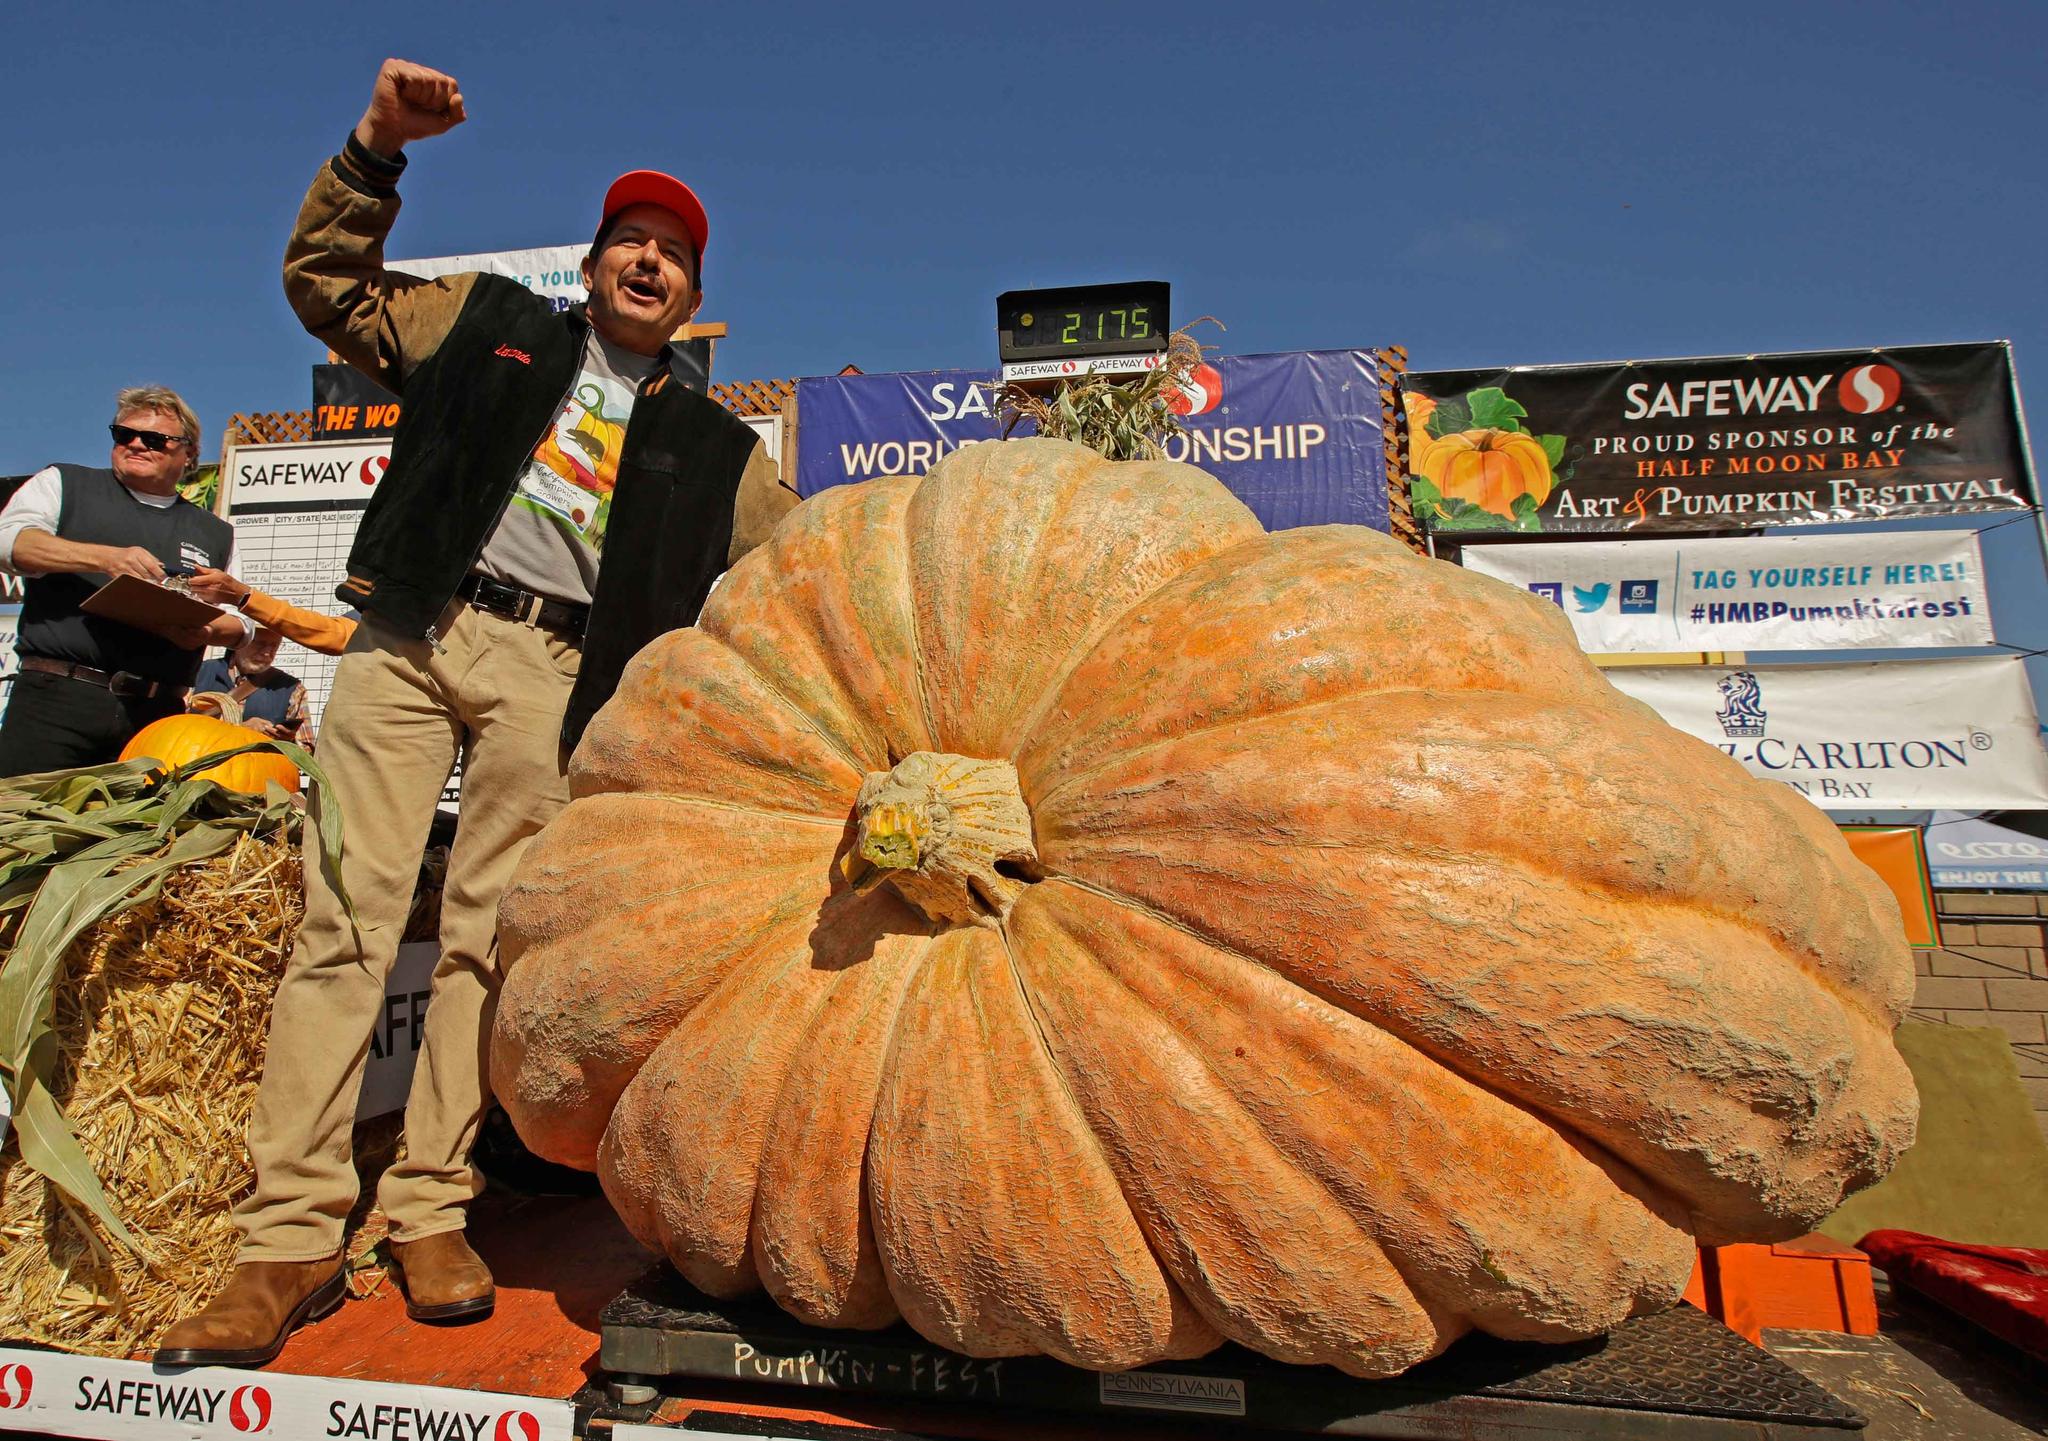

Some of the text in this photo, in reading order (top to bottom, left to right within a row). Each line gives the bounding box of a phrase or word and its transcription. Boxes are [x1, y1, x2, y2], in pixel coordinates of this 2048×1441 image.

[1062, 308, 1149, 343] 2175
[1010, 358, 1142, 376] SAFEWAY SAFEWAY
[1624, 374, 1834, 420] SAFEWAY
[317, 405, 359, 431] THE
[1594, 423, 1955, 454] PROUD SPONSOR of the
[841, 439, 980, 475] WORL
[1637, 449, 1905, 478] HALF MOON BAY
[239, 461, 353, 487] SAFEWAY
[539, 478, 574, 500] Pumpkin
[1554, 478, 2014, 525] ART & PUMPKIN FESTIVAL
[236, 516, 269, 525] GROWER
[275, 514, 320, 523] CITY/STATE
[321, 513, 337, 521] PLACE
[1692, 561, 1966, 589] TAG YOURSELF HERE!
[1820, 778, 1873, 798] BAY
[1938, 870, 1999, 884] ENJOY
[2002, 870, 2043, 884] THE
[1103, 1373, 1241, 1399] PENNSYLVANIA
[75, 1376, 491, 1441] SAFEWAY SAFEWAY
